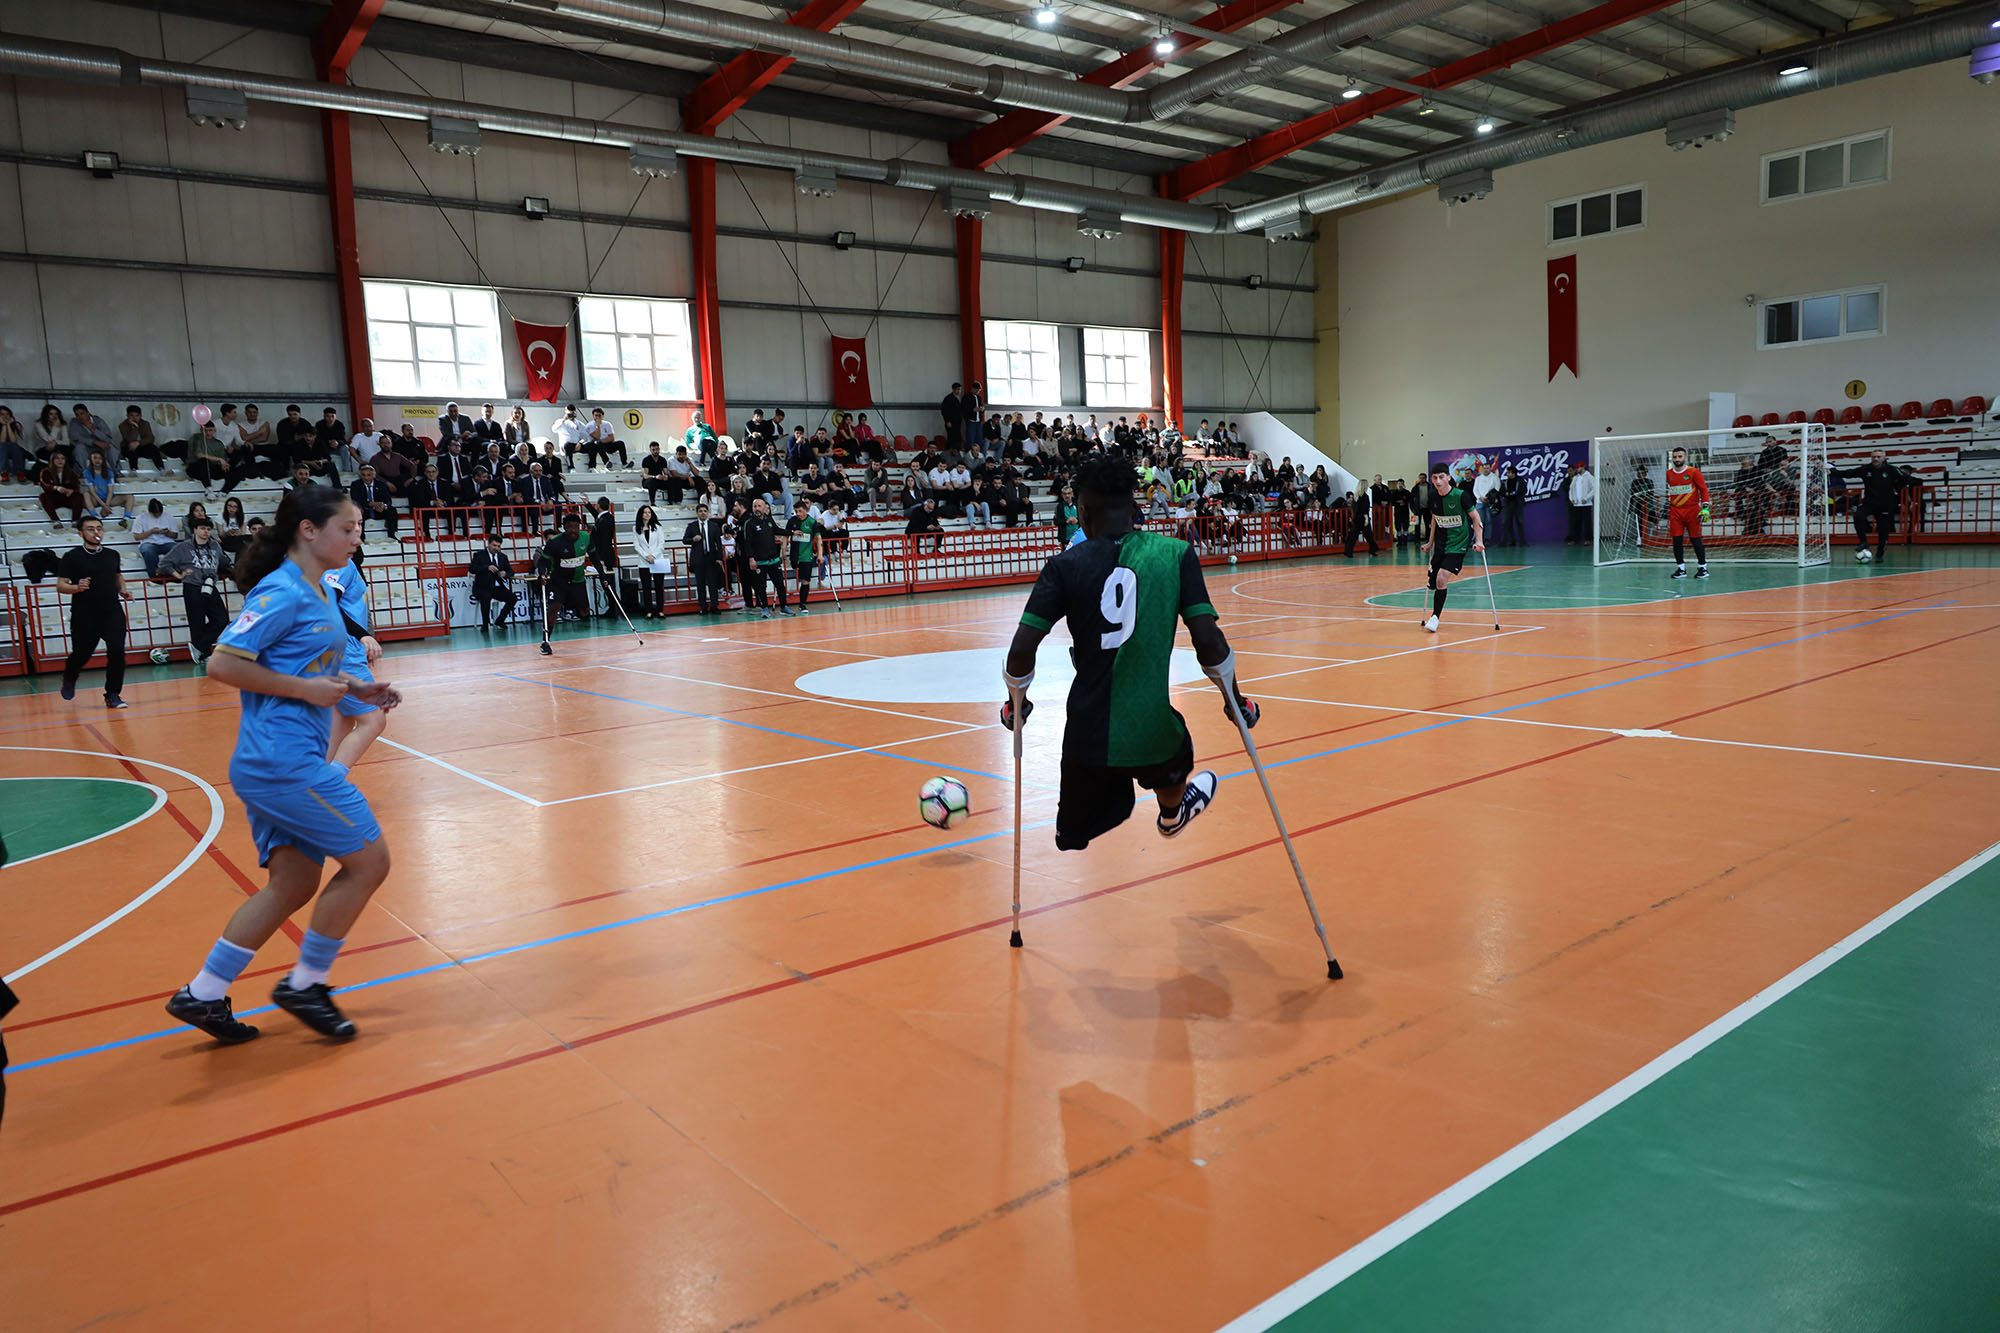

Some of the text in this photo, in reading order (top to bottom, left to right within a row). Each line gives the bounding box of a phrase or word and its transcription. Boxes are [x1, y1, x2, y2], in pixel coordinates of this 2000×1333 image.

[629, 412, 640, 426] D
[1516, 450, 1569, 477] SPOR
[549, 591, 555, 600] 2
[1100, 566, 1138, 650] 9
